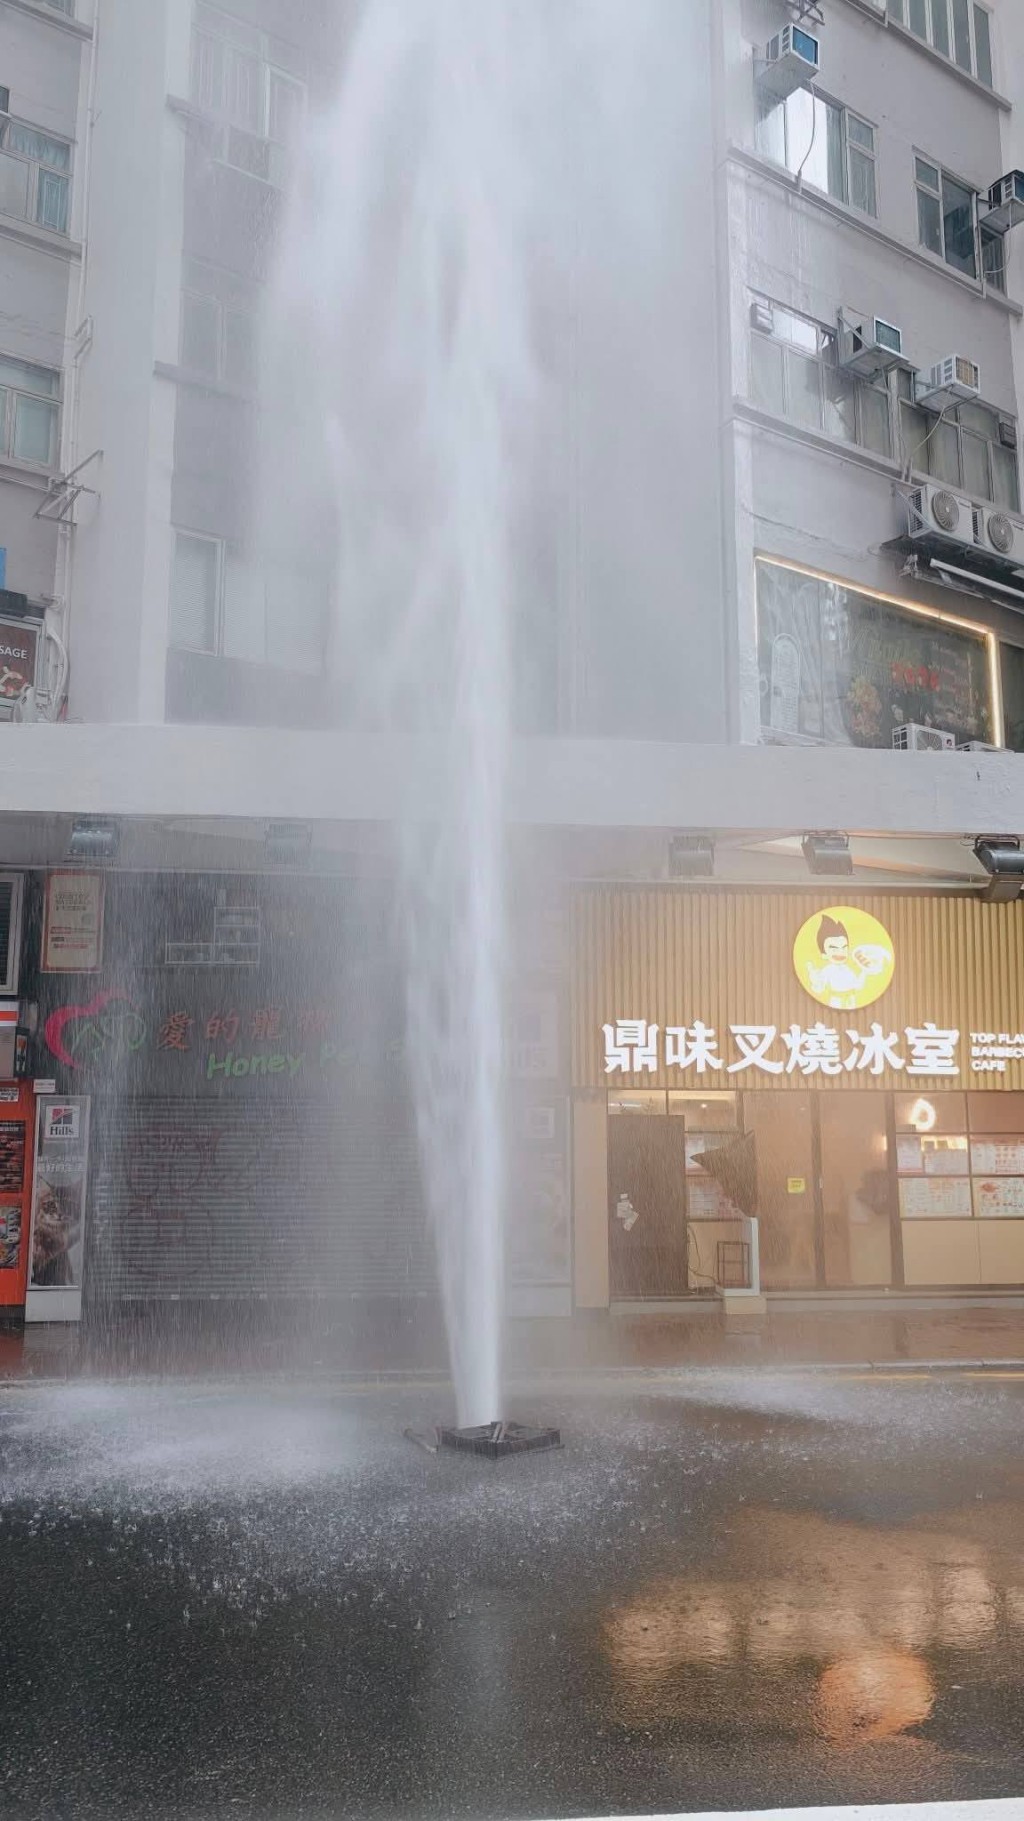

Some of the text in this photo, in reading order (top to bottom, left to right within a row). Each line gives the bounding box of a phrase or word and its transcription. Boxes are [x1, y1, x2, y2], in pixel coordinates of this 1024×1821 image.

[602, 1019, 960, 1075] 鼎味叉燒冰室
[970, 1033, 996, 1044] TOP
[206, 1053, 304, 1079] Honey
[971, 1060, 1006, 1072] CAFE
